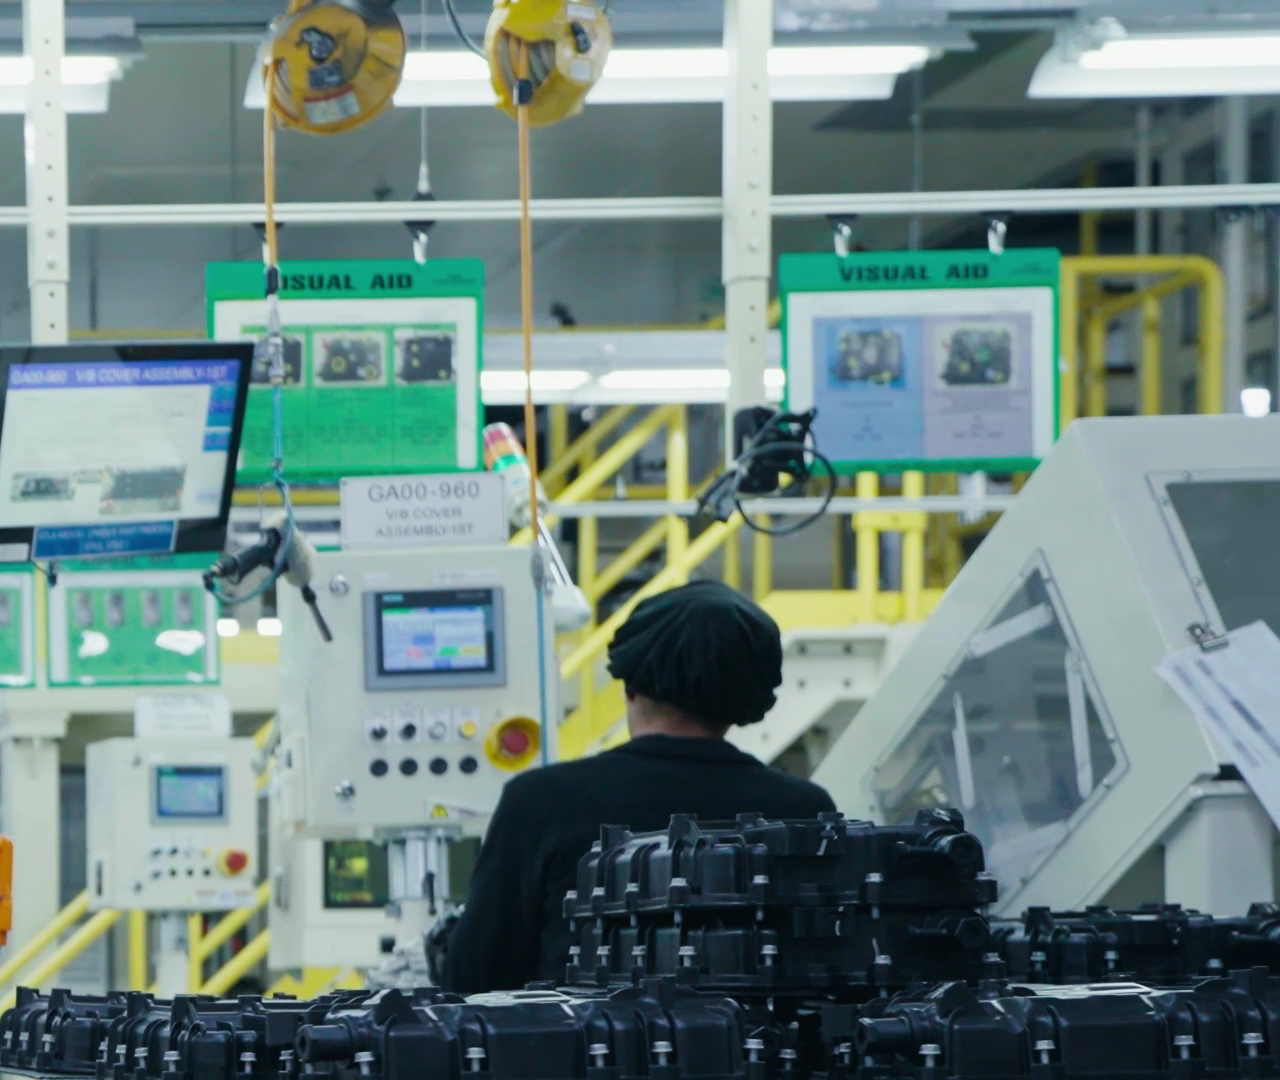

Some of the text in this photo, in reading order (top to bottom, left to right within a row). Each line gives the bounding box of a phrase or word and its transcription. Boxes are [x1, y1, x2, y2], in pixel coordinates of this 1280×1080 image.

[282, 273, 413, 290] ISUAL AID
[840, 264, 989, 282] VISUAL AID
[98, 368, 140, 383] COVER
[367, 480, 480, 503] GA00-960
[385, 505, 462, 521] V/B COVER
